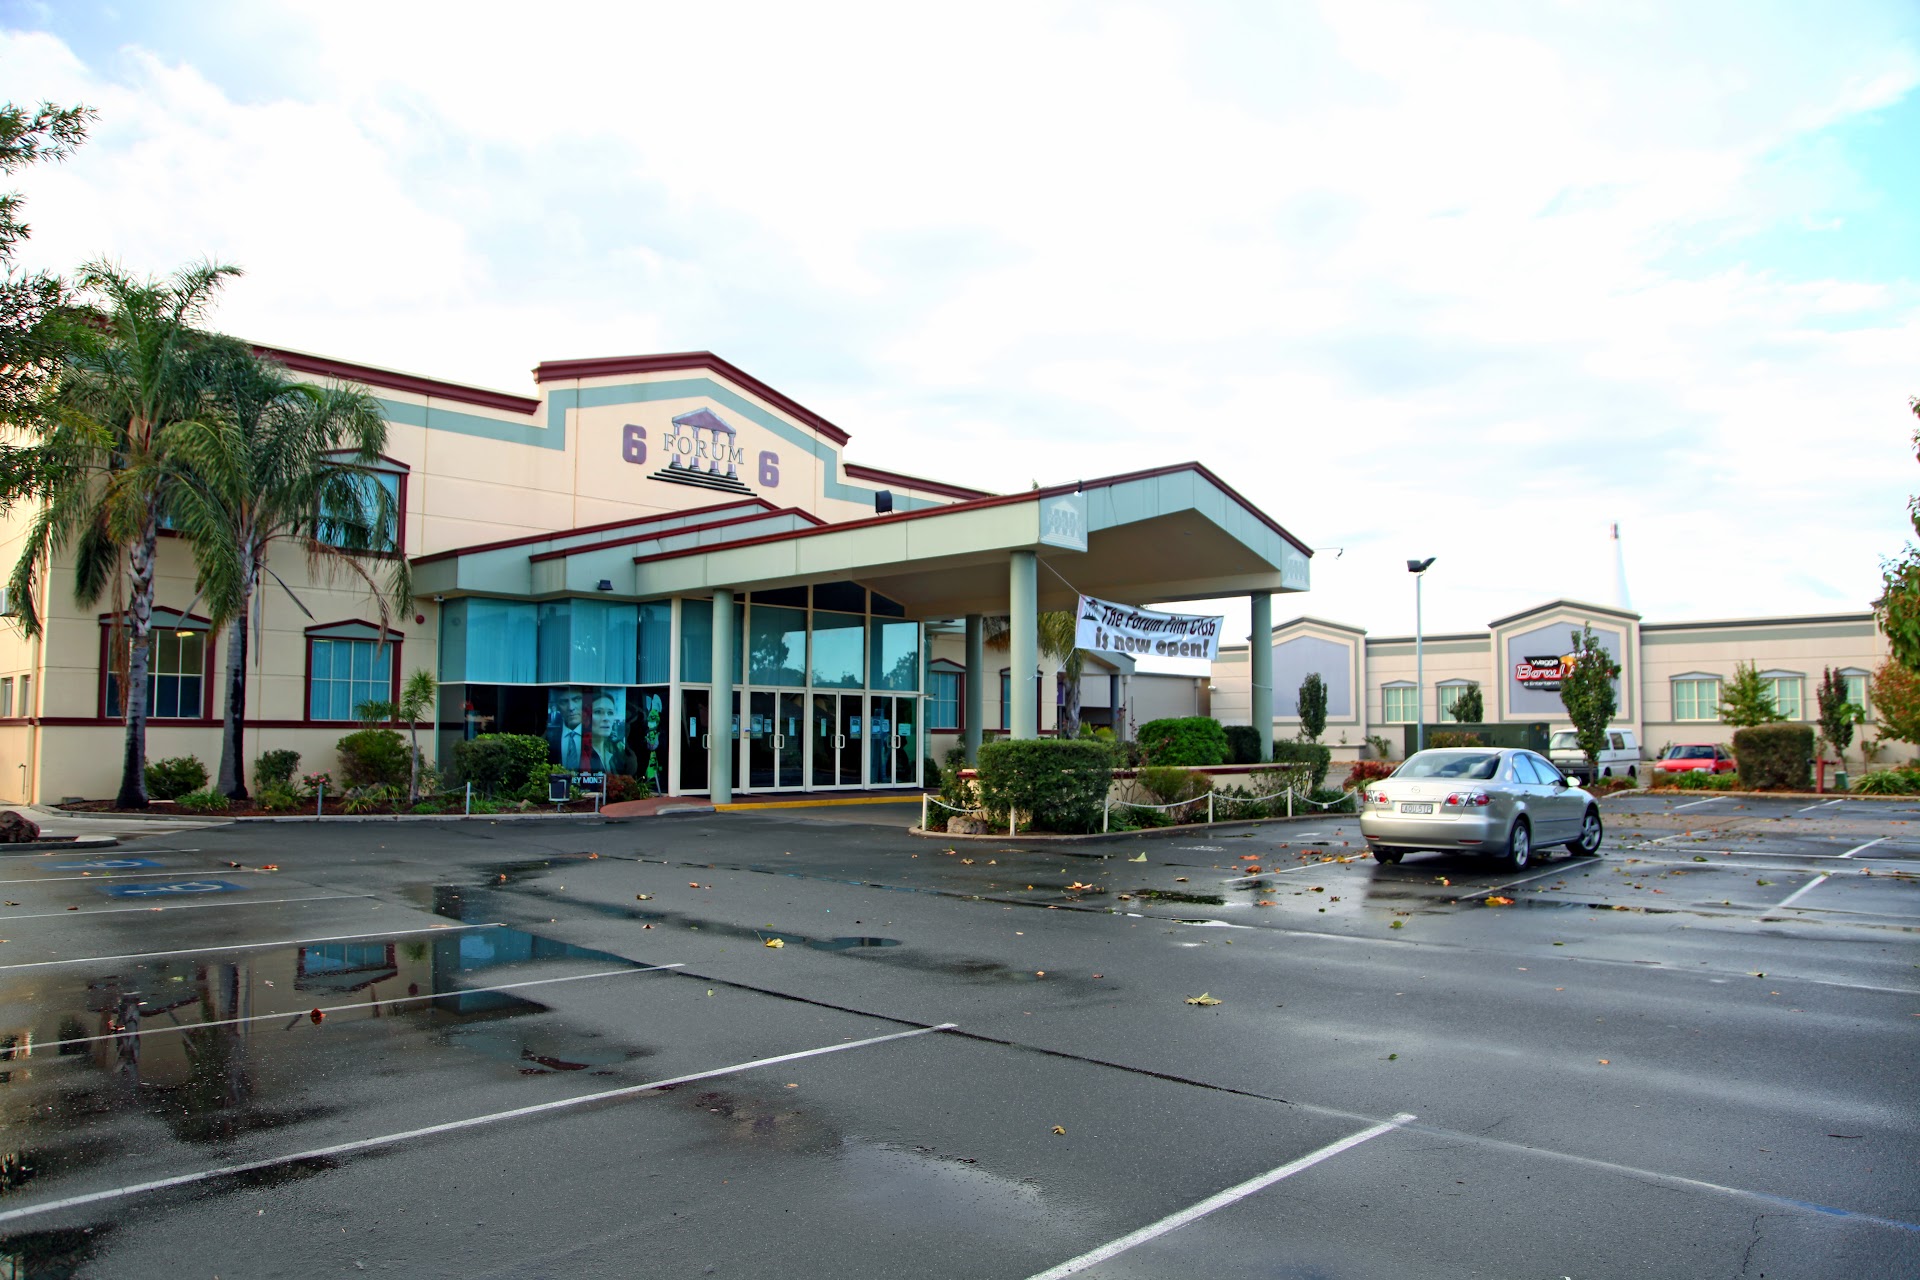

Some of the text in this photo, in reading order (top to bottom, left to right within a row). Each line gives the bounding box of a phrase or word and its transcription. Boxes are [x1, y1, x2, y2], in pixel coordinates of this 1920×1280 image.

[622, 423, 647, 465] 6
[663, 432, 744, 464] FORUM
[759, 450, 779, 488] 6
[1101, 605, 1124, 628] The
[1125, 611, 1164, 632] Forum
[1163, 616, 1188, 635] Film
[1190, 618, 1216, 637] Club
[1095, 626, 1209, 657] is now open!
